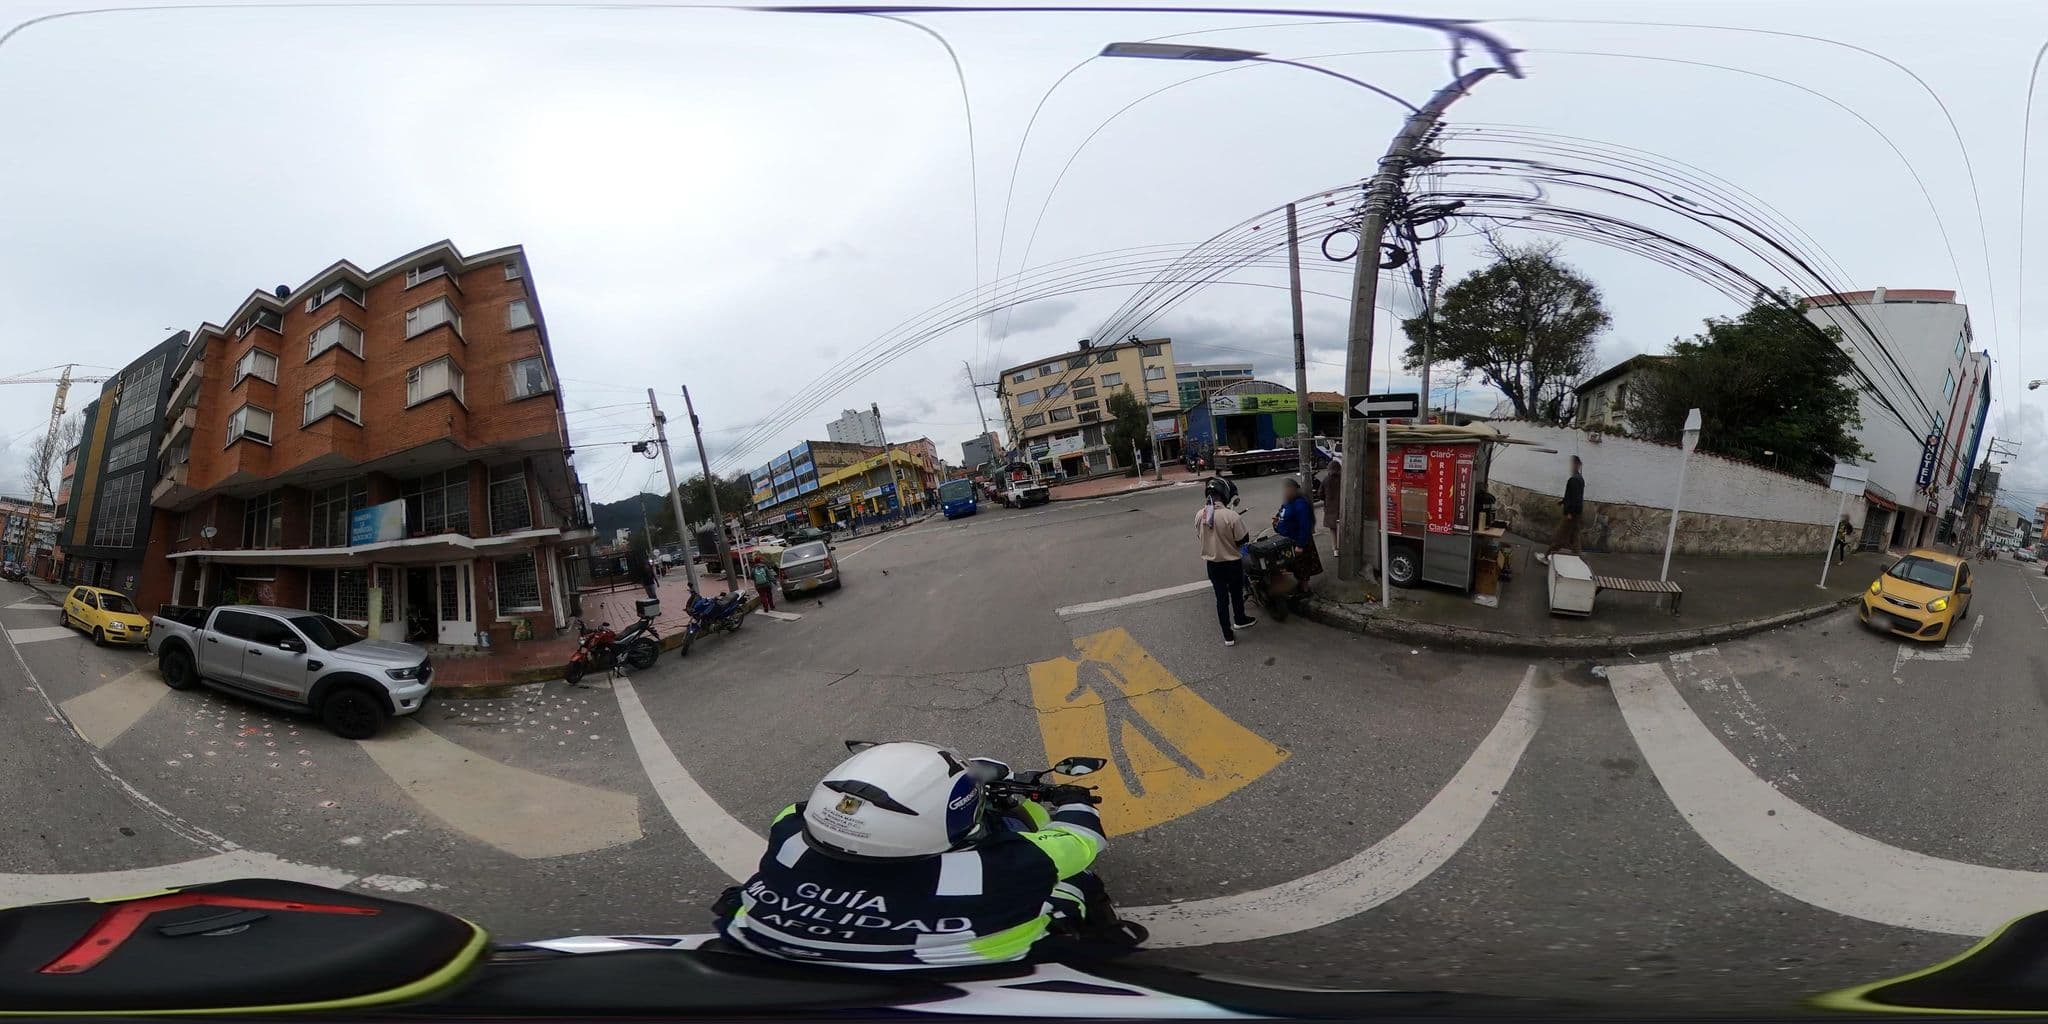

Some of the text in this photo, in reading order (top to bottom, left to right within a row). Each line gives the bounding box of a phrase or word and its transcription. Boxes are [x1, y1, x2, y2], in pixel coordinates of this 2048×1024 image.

[1430, 450, 1452, 458] Claro
[1459, 467, 1468, 519] MINUTOS
[1428, 523, 1451, 532] Claro
[748, 880, 973, 932] MOVILIDAD
[796, 882, 888, 913] GUÍA
